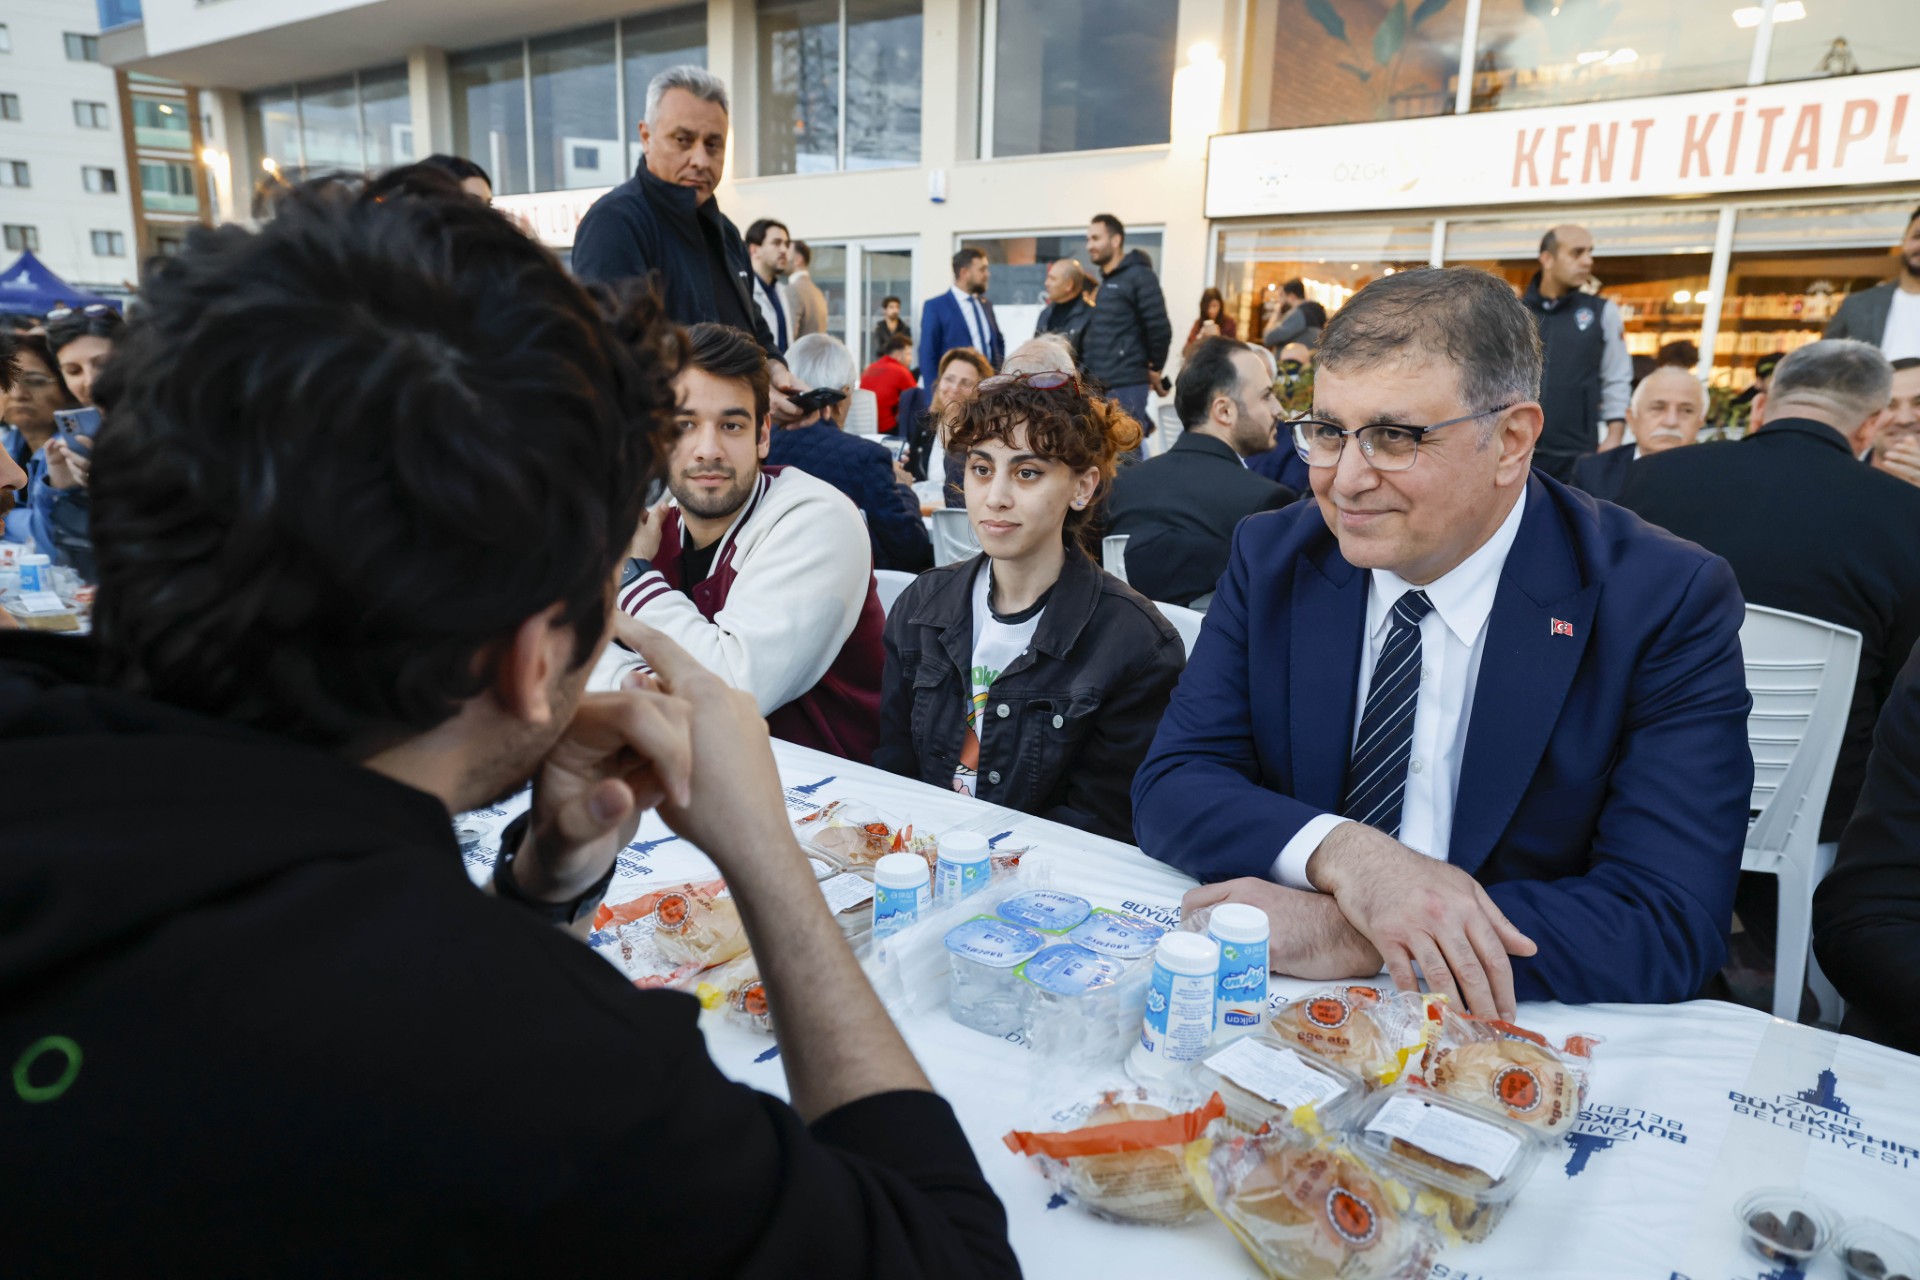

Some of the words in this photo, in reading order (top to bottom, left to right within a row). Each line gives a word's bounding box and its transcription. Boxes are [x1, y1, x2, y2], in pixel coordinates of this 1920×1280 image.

[1511, 118, 1655, 188] KENT
[1678, 93, 1911, 179] KİTAPL
[1226, 1014, 1260, 1026] Balkan
[1297, 1030, 1323, 1042] ege
[1327, 1036, 1350, 1046] ata
[1552, 1072, 1564, 1096] ata
[1548, 1099, 1563, 1126] ege
